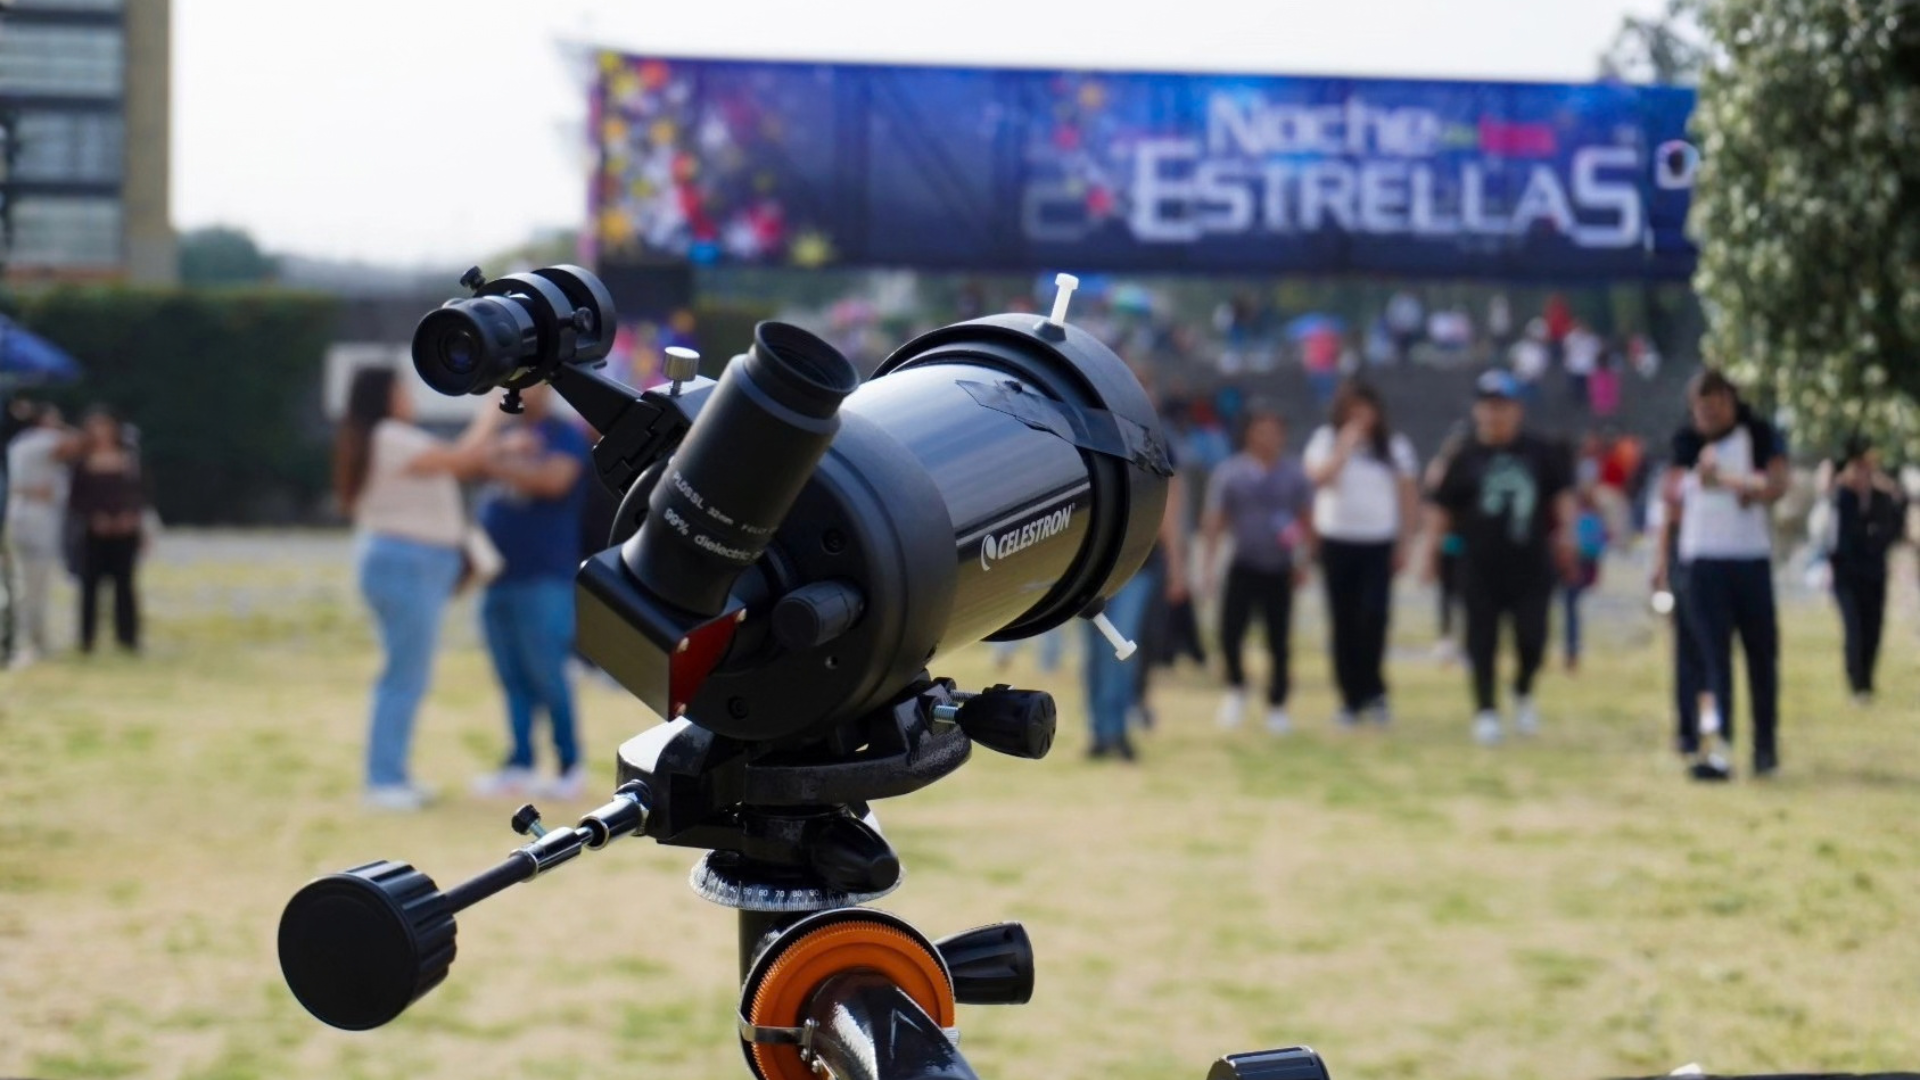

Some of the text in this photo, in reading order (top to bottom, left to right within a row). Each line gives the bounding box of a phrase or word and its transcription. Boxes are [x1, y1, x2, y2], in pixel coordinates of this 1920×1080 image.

[1206, 93, 1440, 157] Noche
[1130, 138, 1642, 248] ESTRELLAS
[663, 507, 752, 561] 99% dielectric
[997, 504, 1072, 560] CELESTRON
[758, 888, 769, 897] 60
[775, 889, 785, 898] 70
